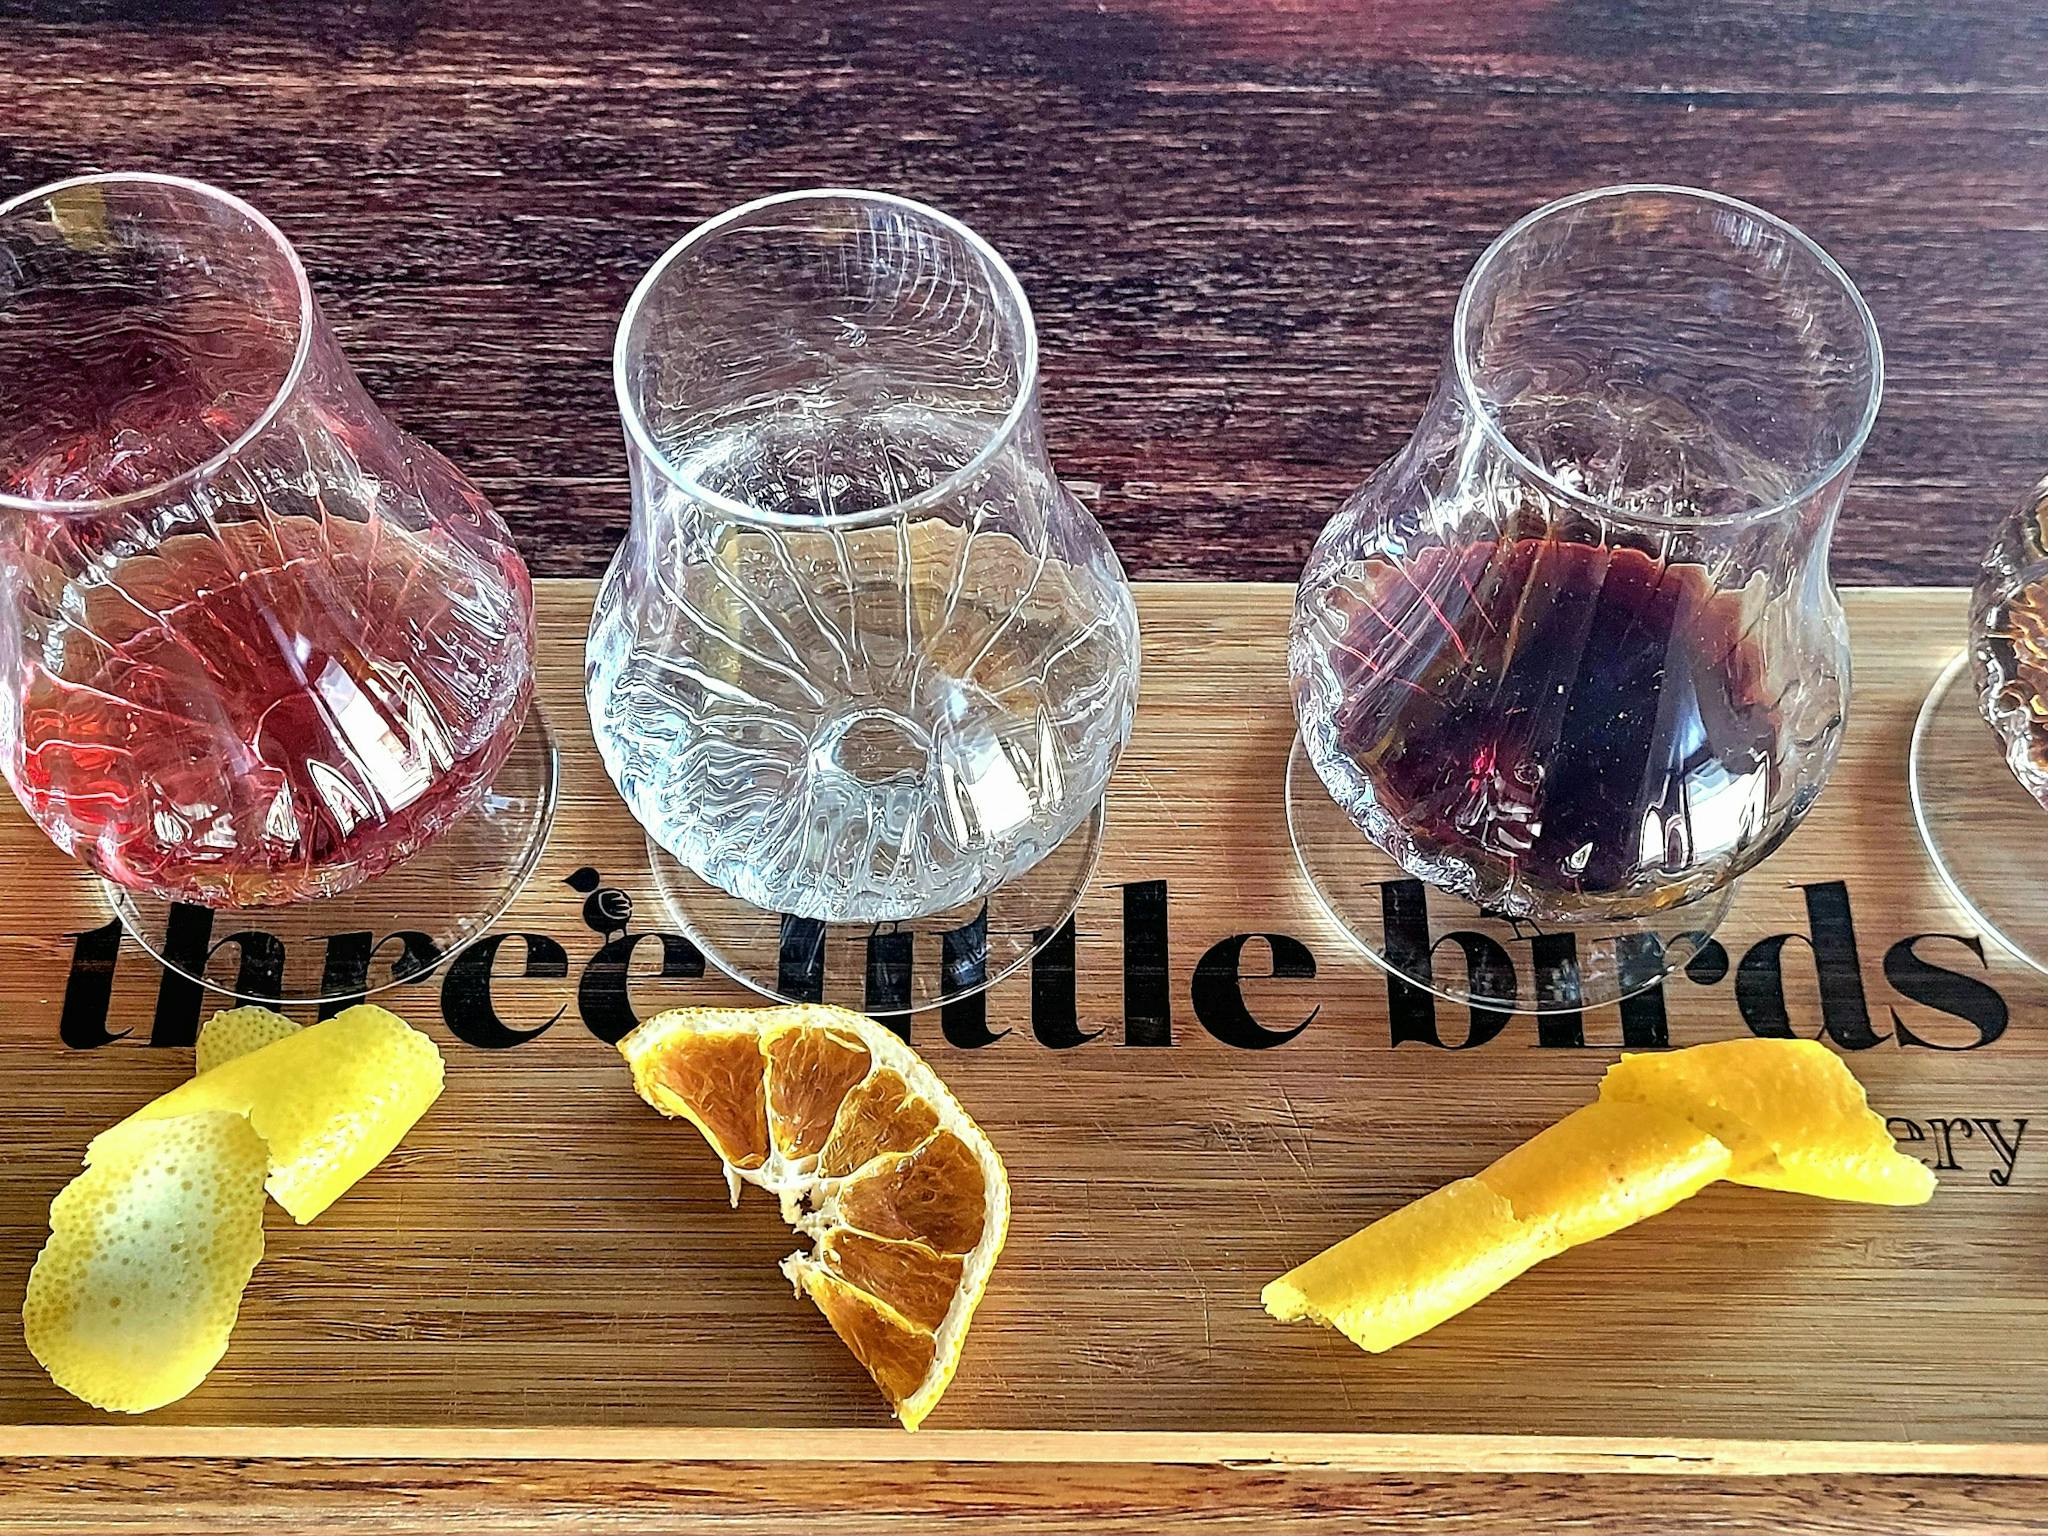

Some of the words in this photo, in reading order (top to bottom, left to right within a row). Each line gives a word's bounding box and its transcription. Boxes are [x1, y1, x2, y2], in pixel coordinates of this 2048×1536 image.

[59, 893, 706, 1049] three
[777, 879, 1320, 1048] little
[1361, 878, 2010, 1051] birds
